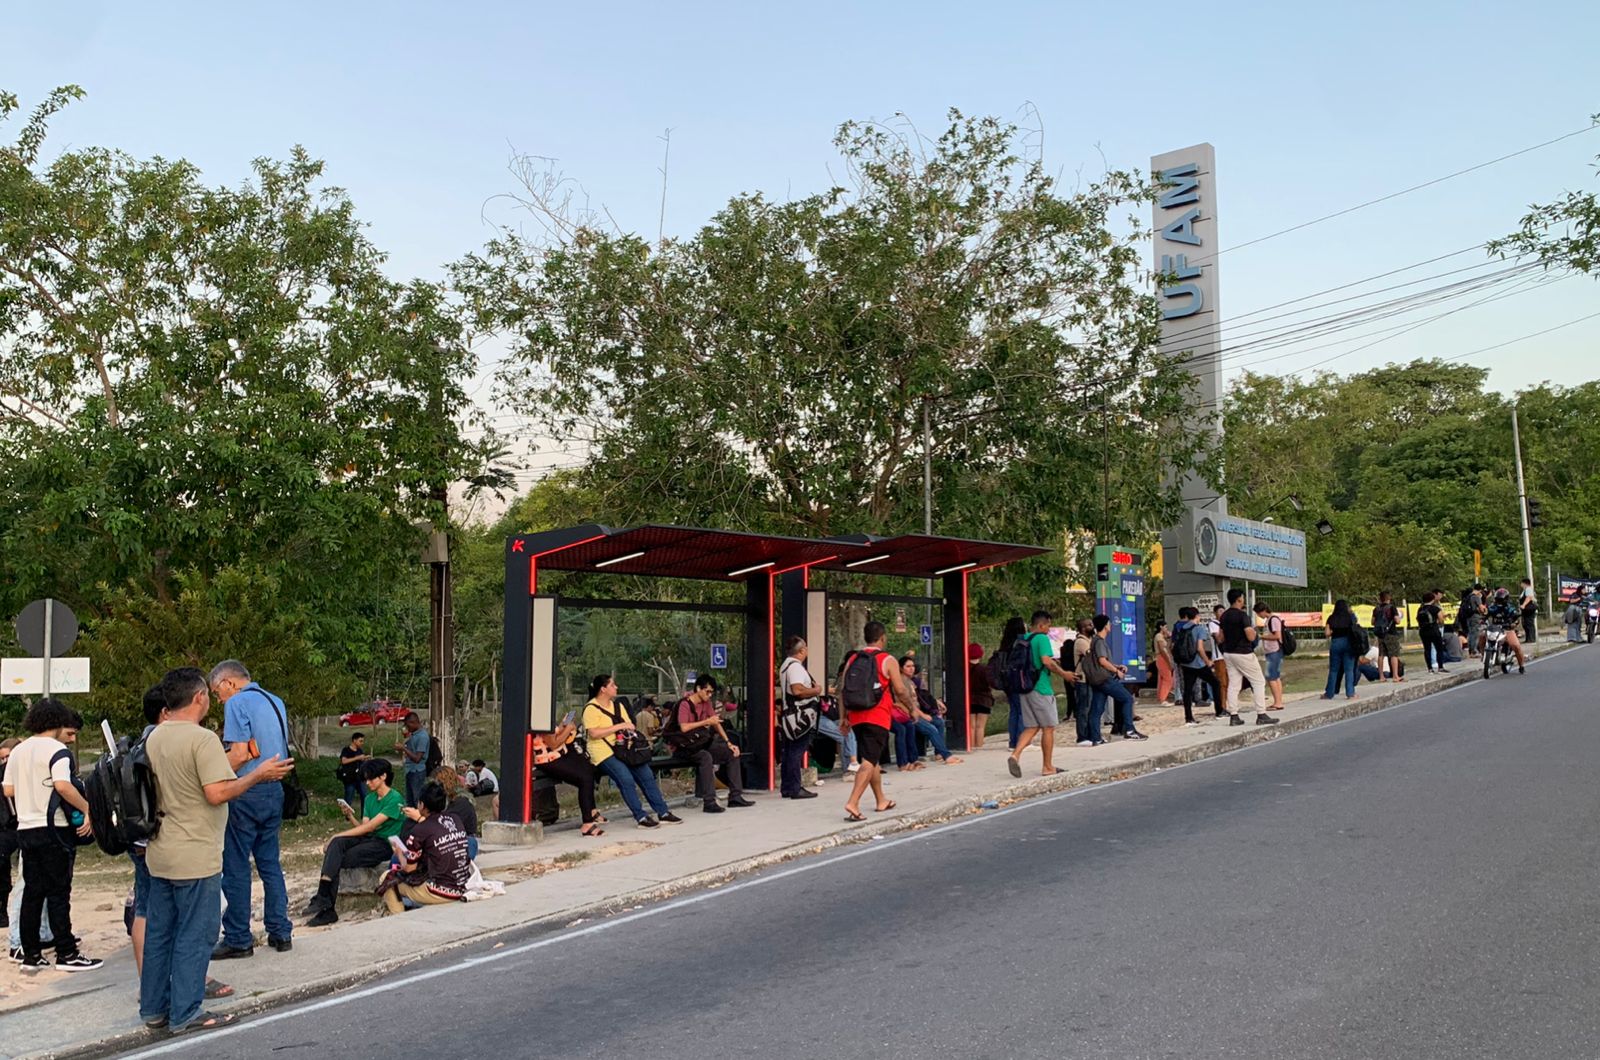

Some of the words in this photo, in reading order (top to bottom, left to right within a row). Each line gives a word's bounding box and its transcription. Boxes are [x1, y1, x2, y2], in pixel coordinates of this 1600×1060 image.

[1160, 162, 1203, 320] UFAM
[1122, 579, 1143, 596] PAREDÃO
[434, 831, 466, 847] LUCIANO
